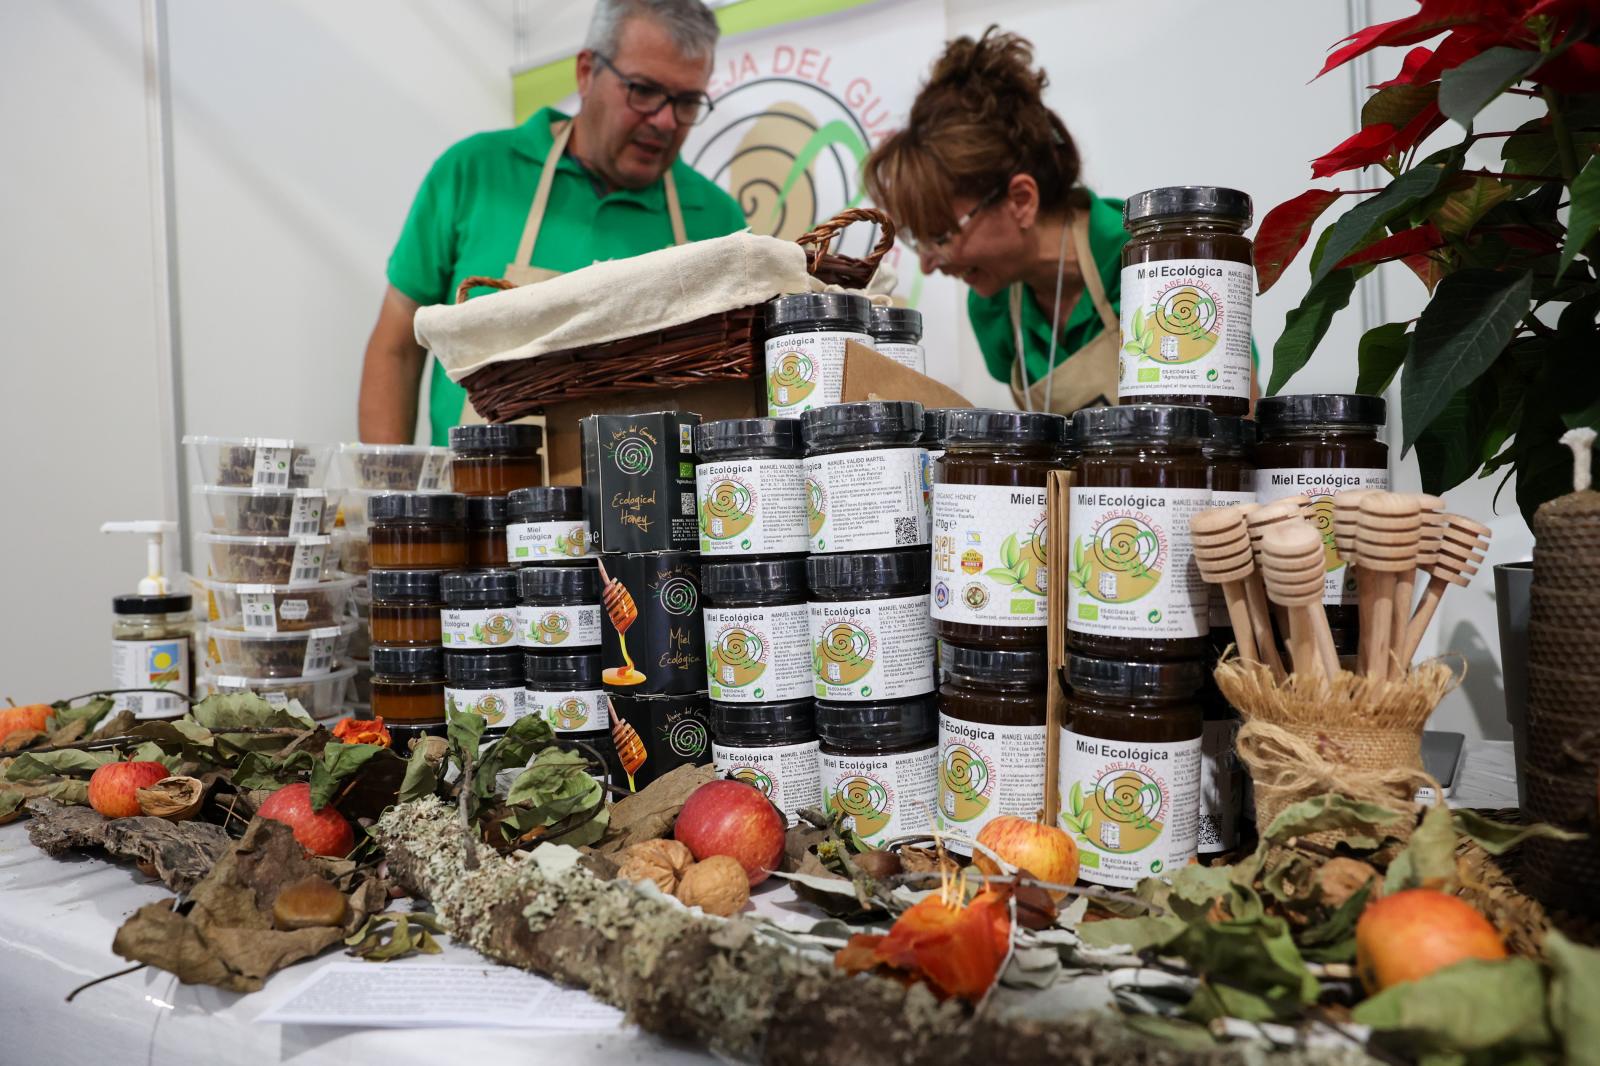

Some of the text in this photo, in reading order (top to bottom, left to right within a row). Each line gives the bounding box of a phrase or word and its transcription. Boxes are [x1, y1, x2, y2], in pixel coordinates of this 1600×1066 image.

[771, 45, 832, 86] DEL
[1161, 265, 1223, 278] Ecológica
[1152, 278, 1225, 334] LA ABEJA DEL GUANCHE
[776, 337, 815, 349] Ecológica
[709, 465, 753, 475] Ecológica
[1271, 474, 1361, 488] Miel Ecológica
[611, 489, 657, 511] Ecological
[1010, 493, 1035, 505] Miel
[1077, 494, 1166, 510] Miel Ecológica
[620, 508, 655, 533] Honey
[1028, 518, 1040, 530] LA
[519, 533, 552, 541] Ecológica
[1090, 508, 1169, 570] LA ABEJA DEL GUANCHE
[719, 613, 764, 623] Ecológica
[824, 607, 871, 617] Ecológica
[669, 626, 691, 651] Miel
[658, 650, 703, 670] Ecológica
[945, 720, 995, 741] Ecológica
[1001, 733, 1023, 741] MANUEL
[729, 753, 774, 763] Ecológica
[1076, 739, 1168, 763] Miel Ecológica
[839, 760, 888, 771] Ecológica
[982, 755, 997, 798] GUANCHE
[1092, 761, 1170, 821] LA ABEJA DEL GUANCHE
